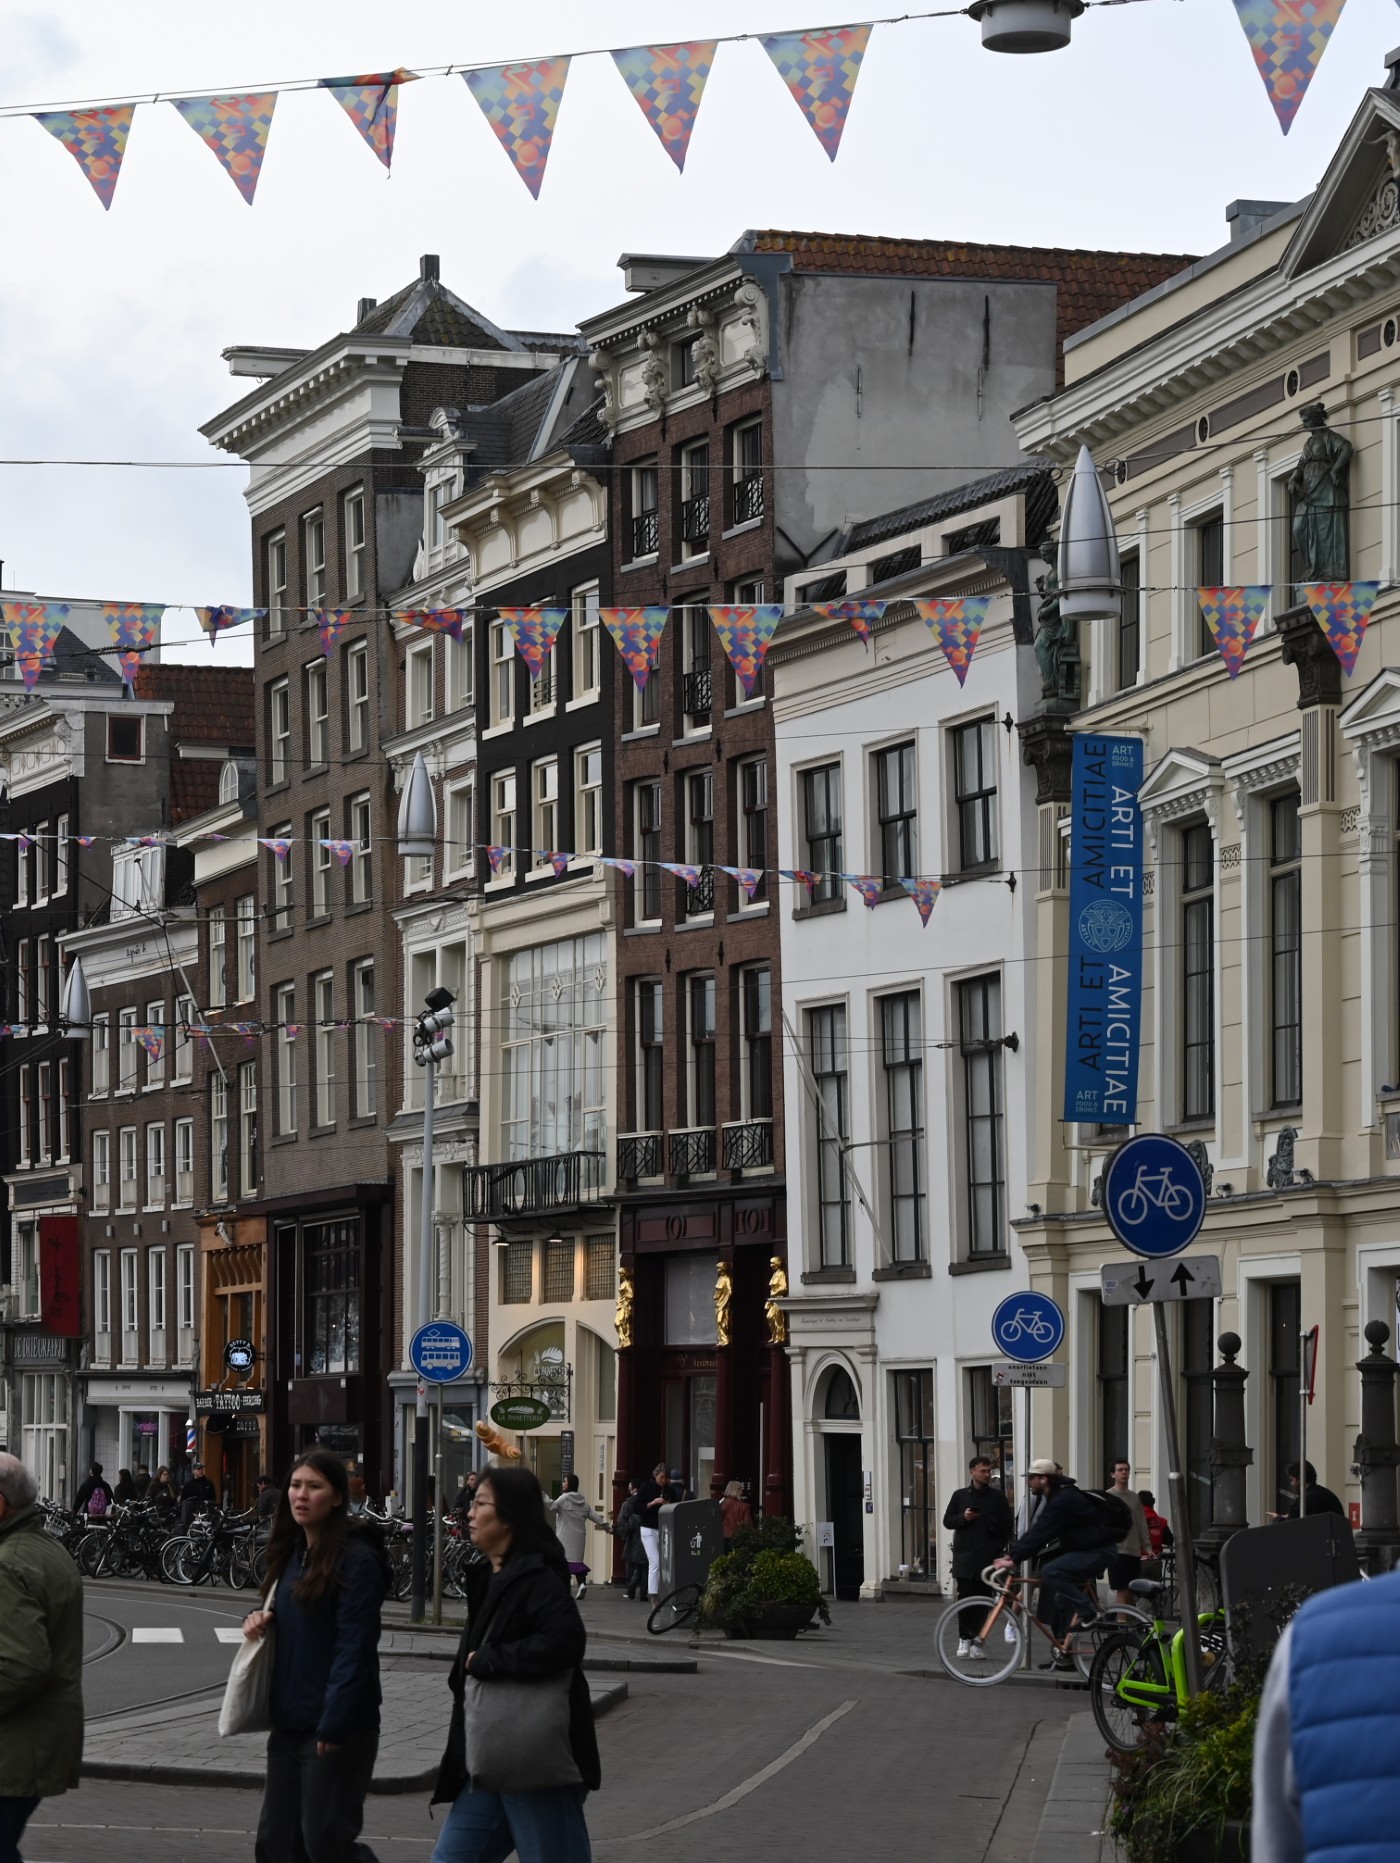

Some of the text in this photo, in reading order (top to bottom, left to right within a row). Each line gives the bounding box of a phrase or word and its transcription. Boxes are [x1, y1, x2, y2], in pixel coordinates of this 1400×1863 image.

[1112, 745, 1134, 755] ART
[1081, 743, 1107, 889] AMICITIAE
[1081, 923, 1089, 939] ARTI
[1103, 785, 1134, 1114] ARTI ET AMICITIAE
[1079, 955, 1104, 990] ET
[1078, 1007, 1103, 1072] ARTI
[1076, 1090, 1099, 1100] ART
[215, 1394, 241, 1410] TATTOO
